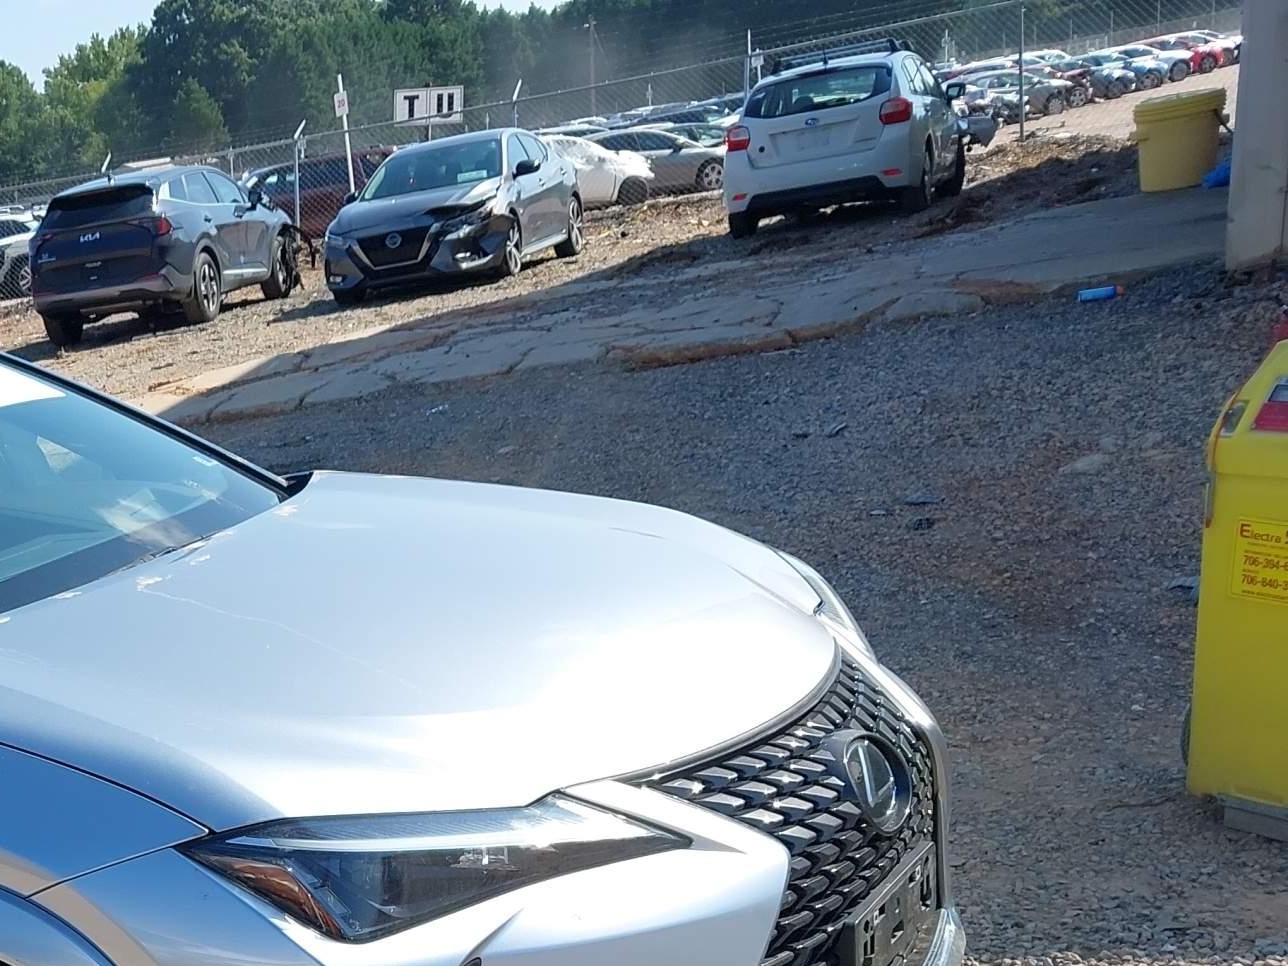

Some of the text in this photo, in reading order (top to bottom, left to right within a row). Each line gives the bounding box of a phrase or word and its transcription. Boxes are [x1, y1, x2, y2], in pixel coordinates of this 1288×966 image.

[404, 95, 419, 118] T
[80, 232, 100, 243] KIA
[1240, 523, 1282, 544] Electra
